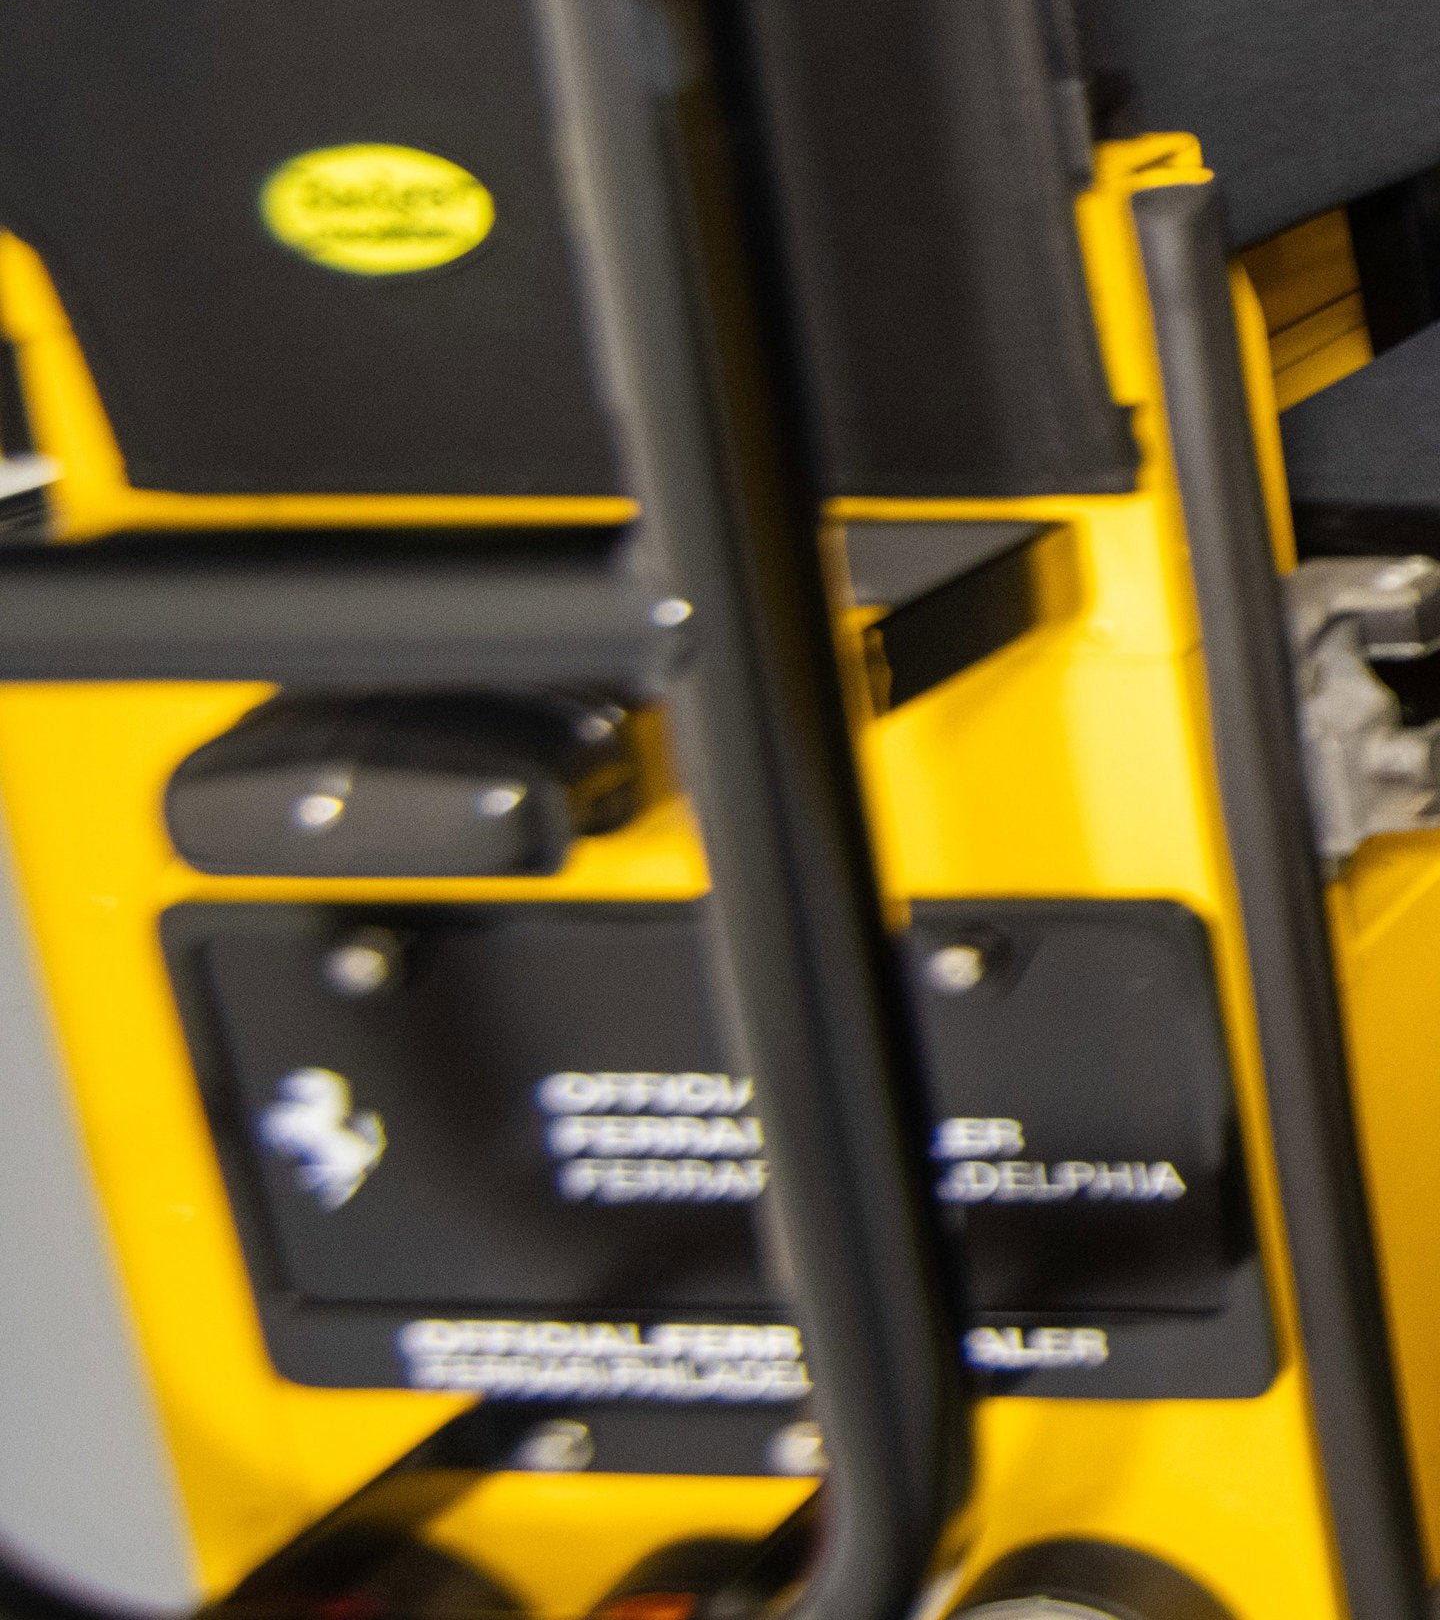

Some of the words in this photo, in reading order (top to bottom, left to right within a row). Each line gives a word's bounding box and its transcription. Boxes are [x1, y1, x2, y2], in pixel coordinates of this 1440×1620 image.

[935, 1161, 1187, 1202] DELPHIA
[398, 1320, 646, 1356] OFFICIAL
[644, 1324, 801, 1359] FERR
